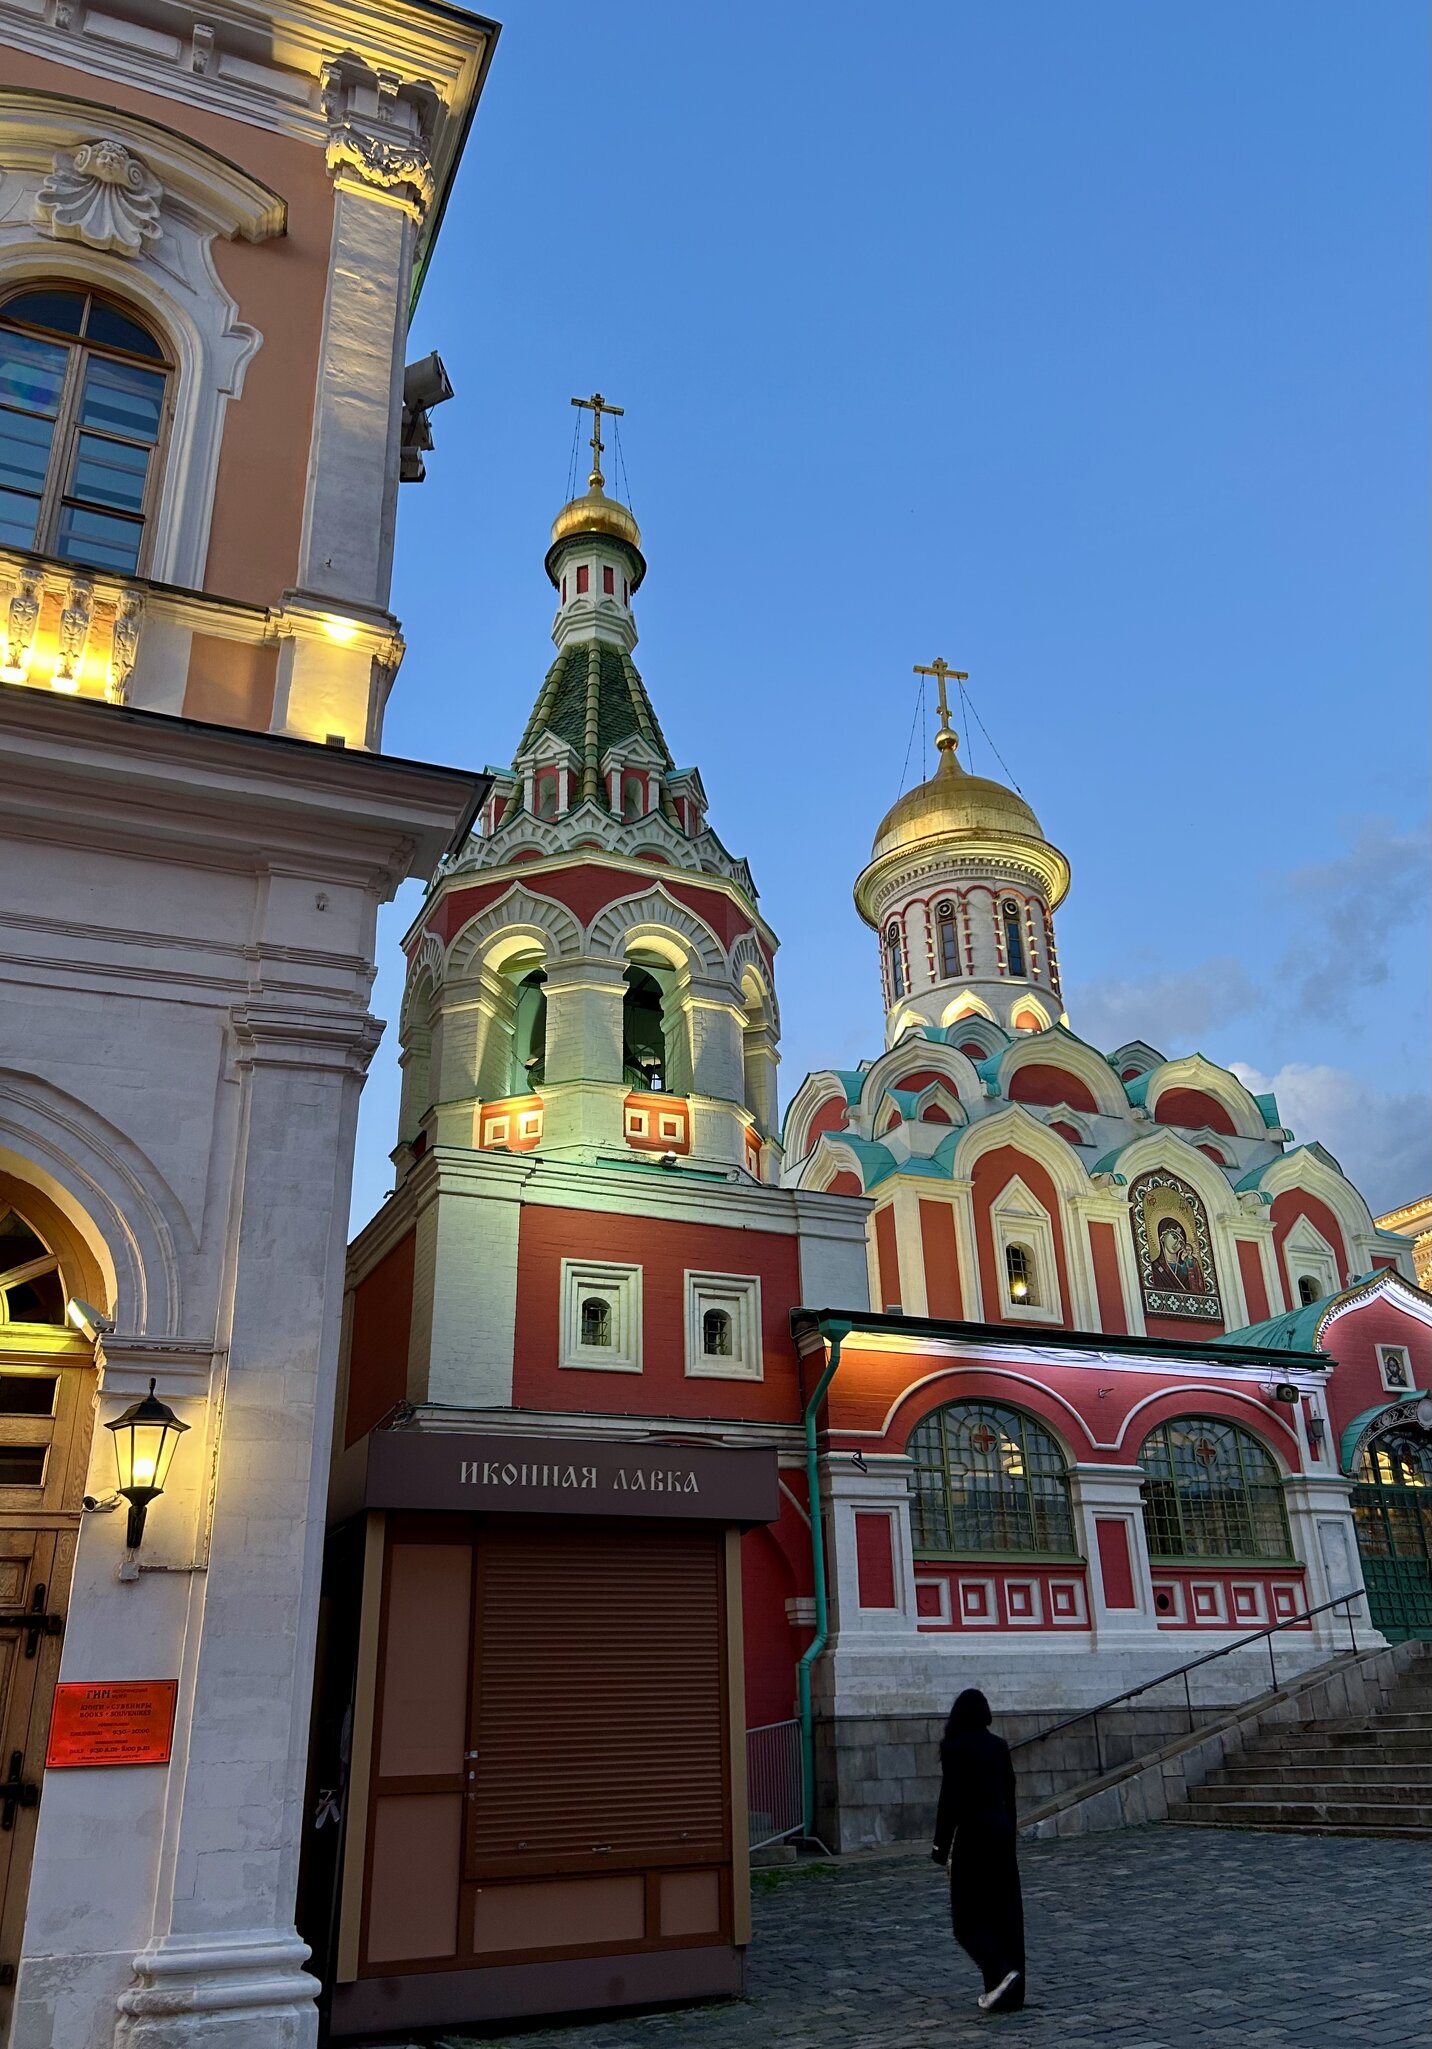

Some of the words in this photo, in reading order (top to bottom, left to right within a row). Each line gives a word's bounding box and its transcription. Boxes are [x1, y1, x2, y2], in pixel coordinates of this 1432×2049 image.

[459, 1461, 597, 1489] ИКОННАЯ
[613, 1469, 700, 1493] ЛАВКА
[87, 1689, 111, 1699] ГИМ
[111, 1702, 152, 1710] СУВЕНИРЫ
